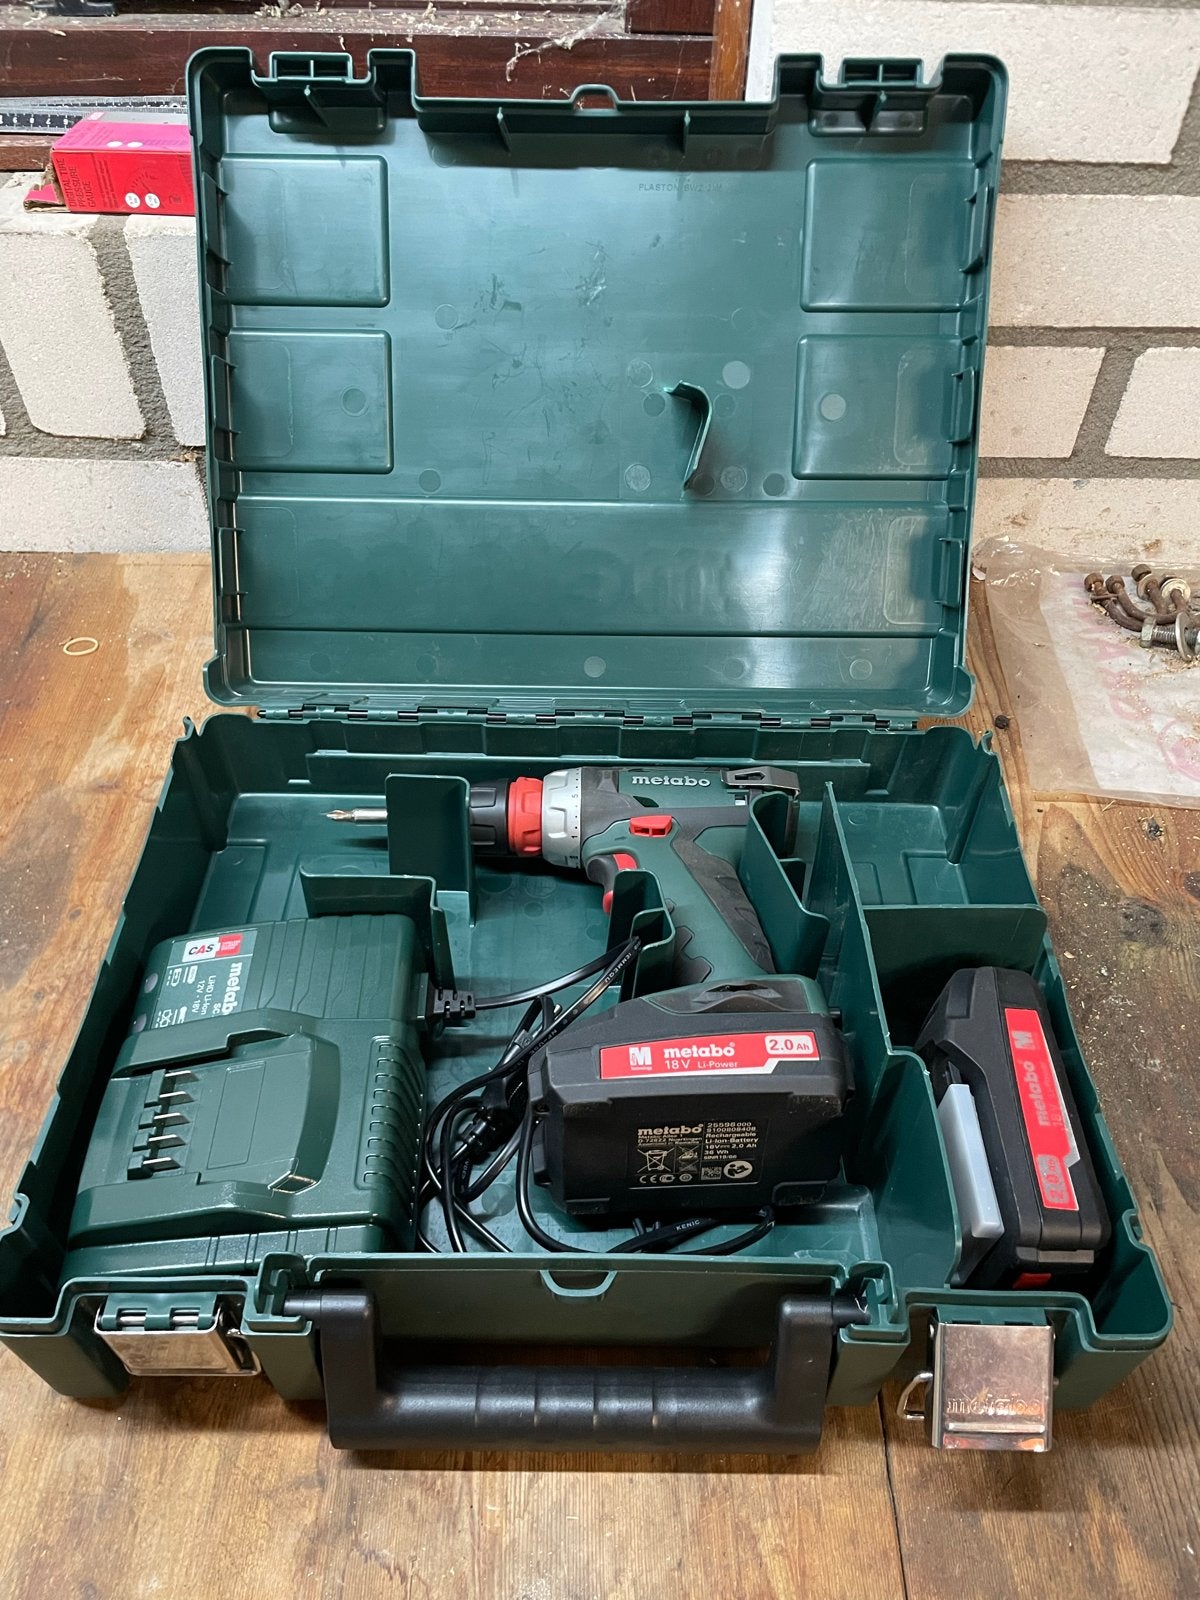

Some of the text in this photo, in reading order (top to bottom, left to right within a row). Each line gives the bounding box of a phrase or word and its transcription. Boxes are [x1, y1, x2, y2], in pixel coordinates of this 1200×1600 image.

[62, 178, 77, 207] DIGITAL
[631, 775, 711, 787] metabo
[188, 943, 215, 956] CAS
[221, 961, 243, 1015] metab
[768, 1039, 810, 1051] 2.0 Ah
[697, 1060, 738, 1069] Li-Power
[637, 1124, 703, 1137] metabo
[705, 1131, 757, 1140] Rechargeable
